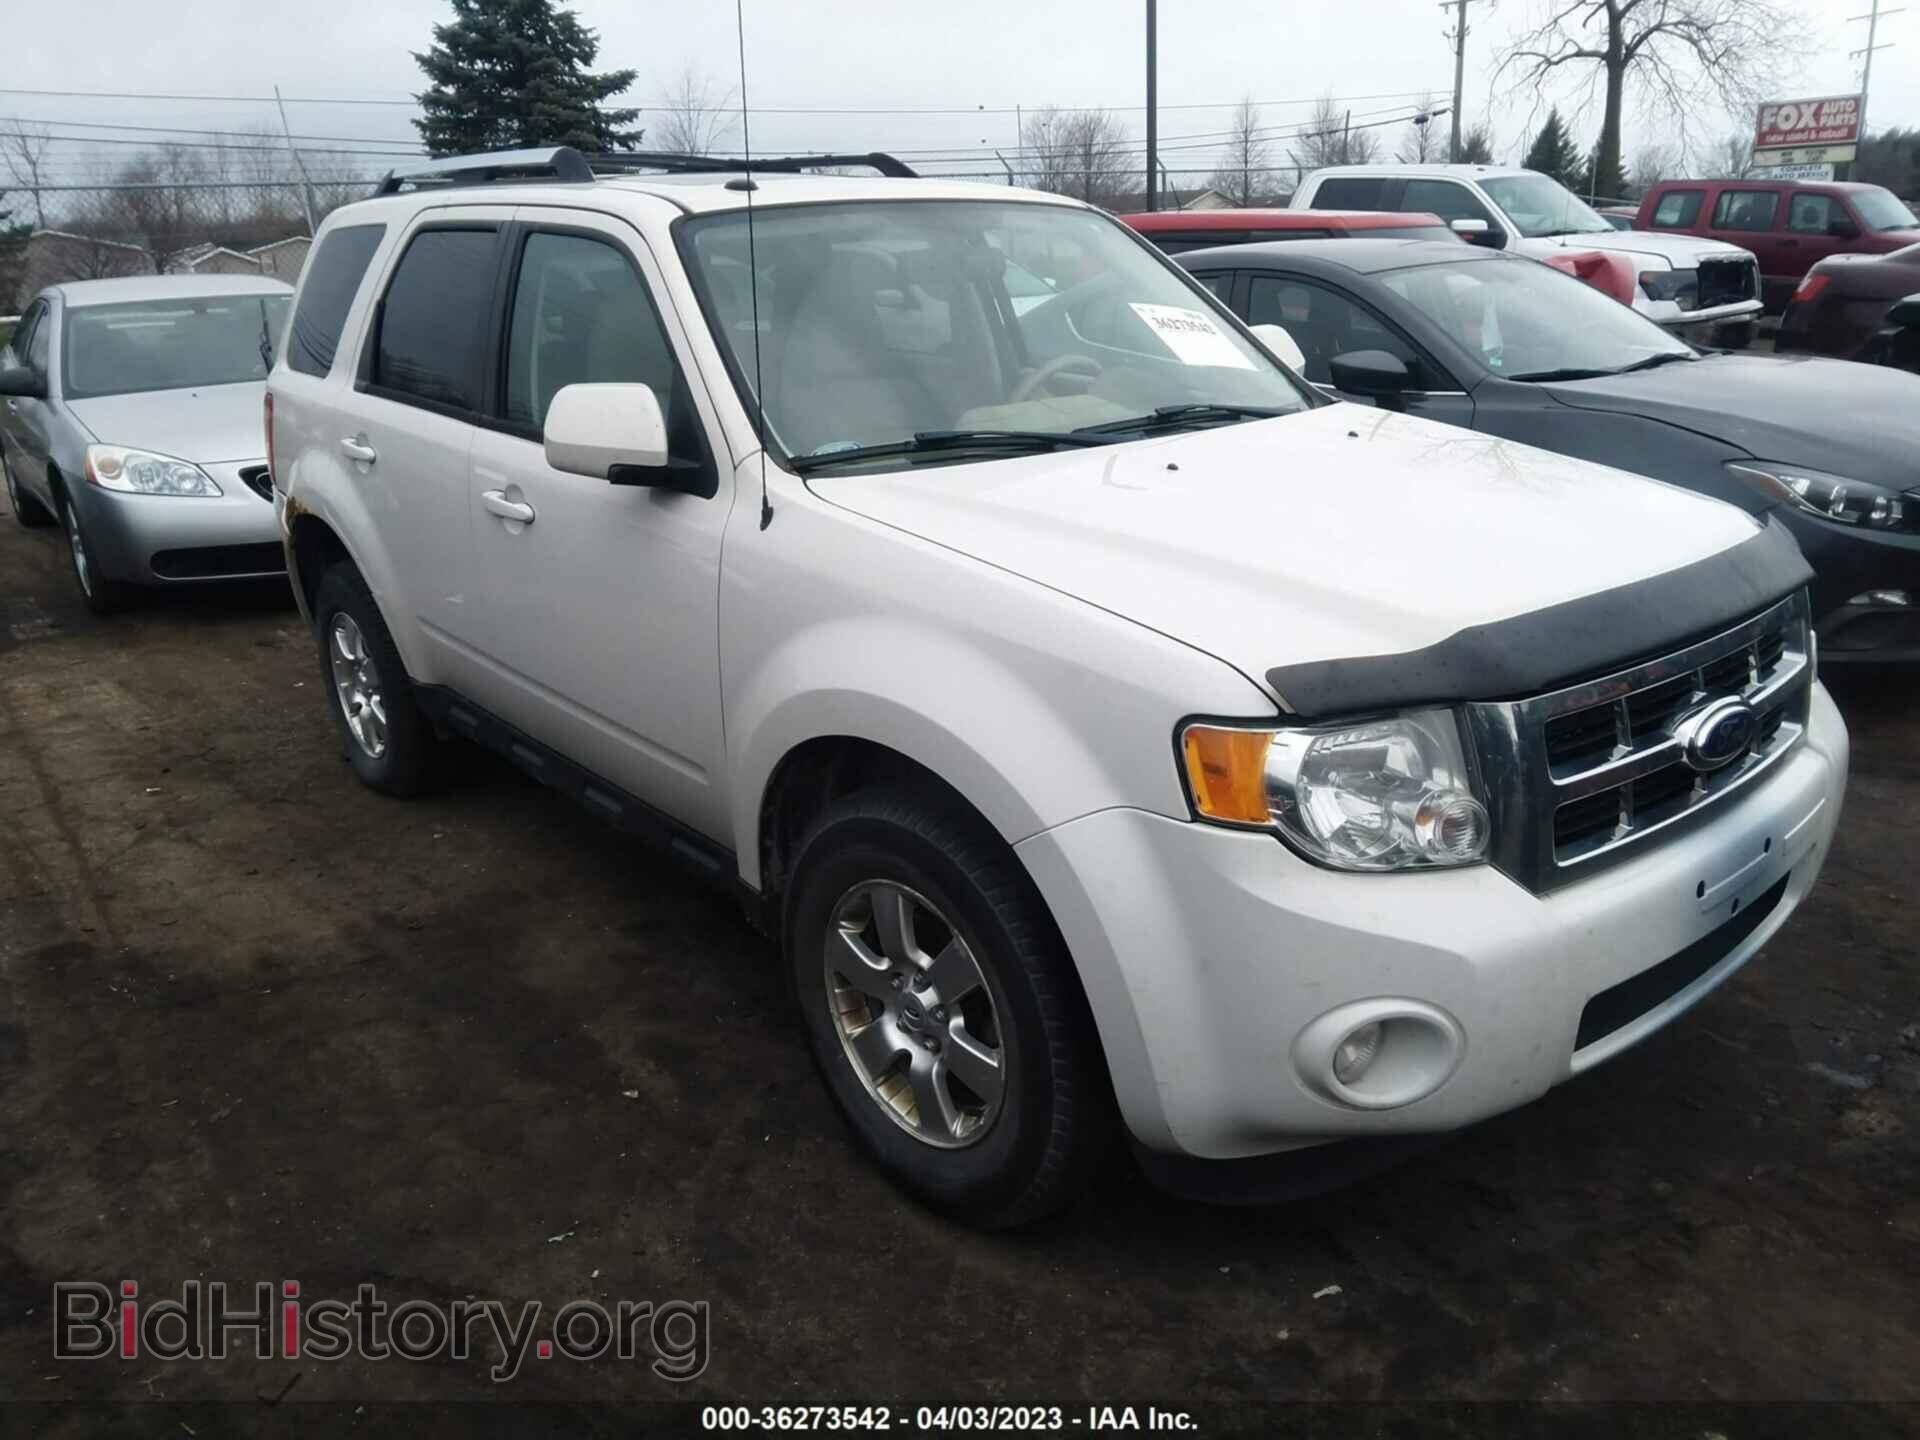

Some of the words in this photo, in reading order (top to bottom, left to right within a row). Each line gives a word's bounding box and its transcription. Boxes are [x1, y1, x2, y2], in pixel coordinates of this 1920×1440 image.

[1823, 100, 1855, 113] AUTO
[1761, 103, 1818, 132] FOX
[1820, 112, 1857, 127] PARTS
